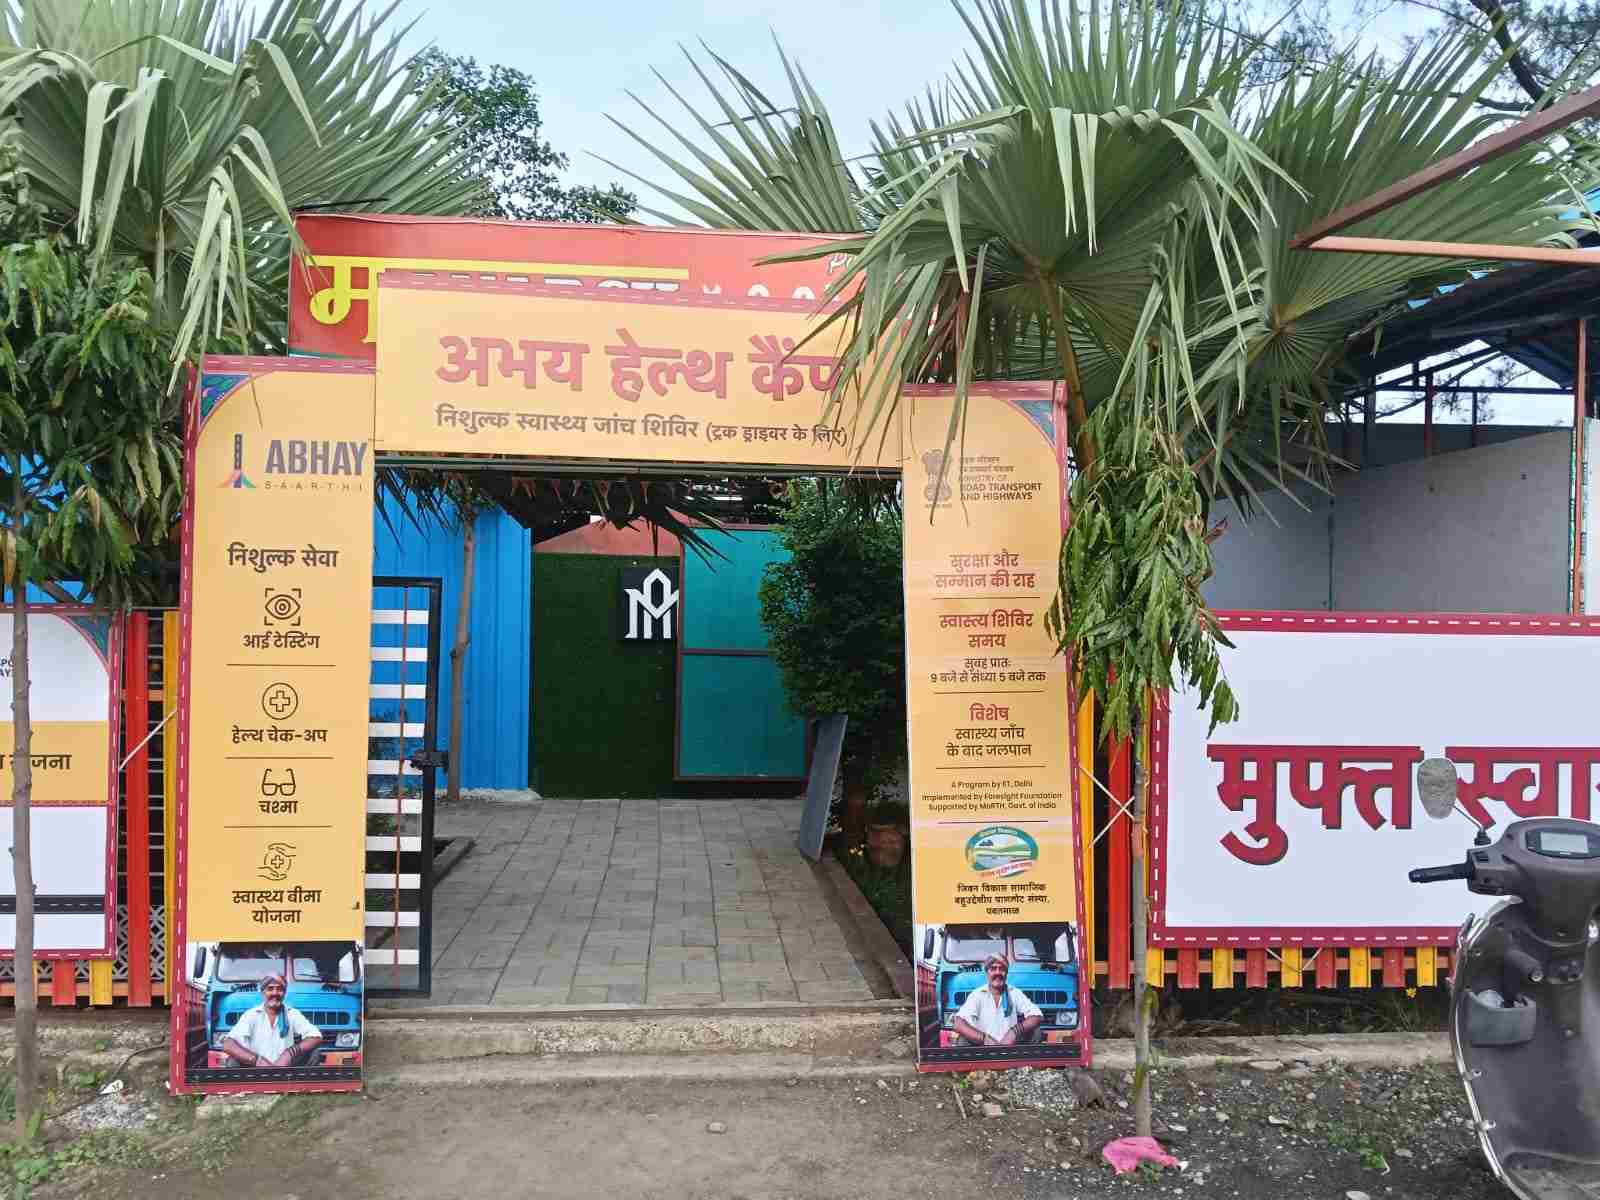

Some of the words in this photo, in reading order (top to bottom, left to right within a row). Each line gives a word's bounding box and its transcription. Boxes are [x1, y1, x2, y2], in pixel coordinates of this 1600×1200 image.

[435, 336, 590, 391] अभय
[604, 328, 733, 402] हेल्थ
[436, 403, 510, 434] निशुल्क
[516, 413, 587, 432] स्वास्थ्य
[592, 412, 635, 434] जांच
[642, 413, 699, 436] शिविर
[742, 424, 787, 442] ड्राइवर
[792, 424, 808, 441] के
[265, 440, 368, 476] ABHAY
[983, 491, 1033, 500] HIGHWAYS
[988, 482, 1041, 491] TRANSPORT
[227, 541, 296, 573] निशुल्क
[301, 543, 339, 568] सेवा
[950, 554, 990, 573] सुरक्षा
[993, 548, 1019, 568] और
[935, 573, 987, 588] सम्मान
[990, 569, 1010, 588] की
[1013, 573, 1035, 588] राह
[992, 609, 1034, 628] शिविर
[243, 630, 272, 649] आई
[274, 631, 321, 649] टेस्टिंग
[968, 634, 1007, 648] समय
[930, 673, 937, 684] 9
[940, 671, 956, 683] बजे
[959, 671, 969, 683] से
[971, 671, 996, 683] संध्या
[999, 674, 1006, 682] 5
[1008, 670, 1025, 683] बजे
[1027, 671, 1046, 682] तक
[970, 702, 1010, 721] विशेष
[232, 725, 264, 744] हेल्थ
[267, 725, 328, 743] चेक-अप
[955, 728, 998, 741] स्वास्थ्य
[946, 742, 959, 758] के
[961, 745, 983, 757] बाद
[986, 744, 1032, 757] जलपान
[958, 781, 990, 789] Program
[992, 781, 1000, 789] by
[1014, 780, 1033, 788] Delhi
[973, 792, 983, 800] by
[1020, 791, 1062, 799] Foundation
[1207, 744, 1424, 865] मुफ्त
[1445, 746, 1600, 830] स्वा
[258, 800, 298, 814] चश्मा
[929, 803, 967, 812] Supported
[969, 802, 978, 811] by
[232, 890, 284, 904] स्वास्थ्य
[287, 886, 321, 904] बीमा
[252, 905, 301, 923] योजना
